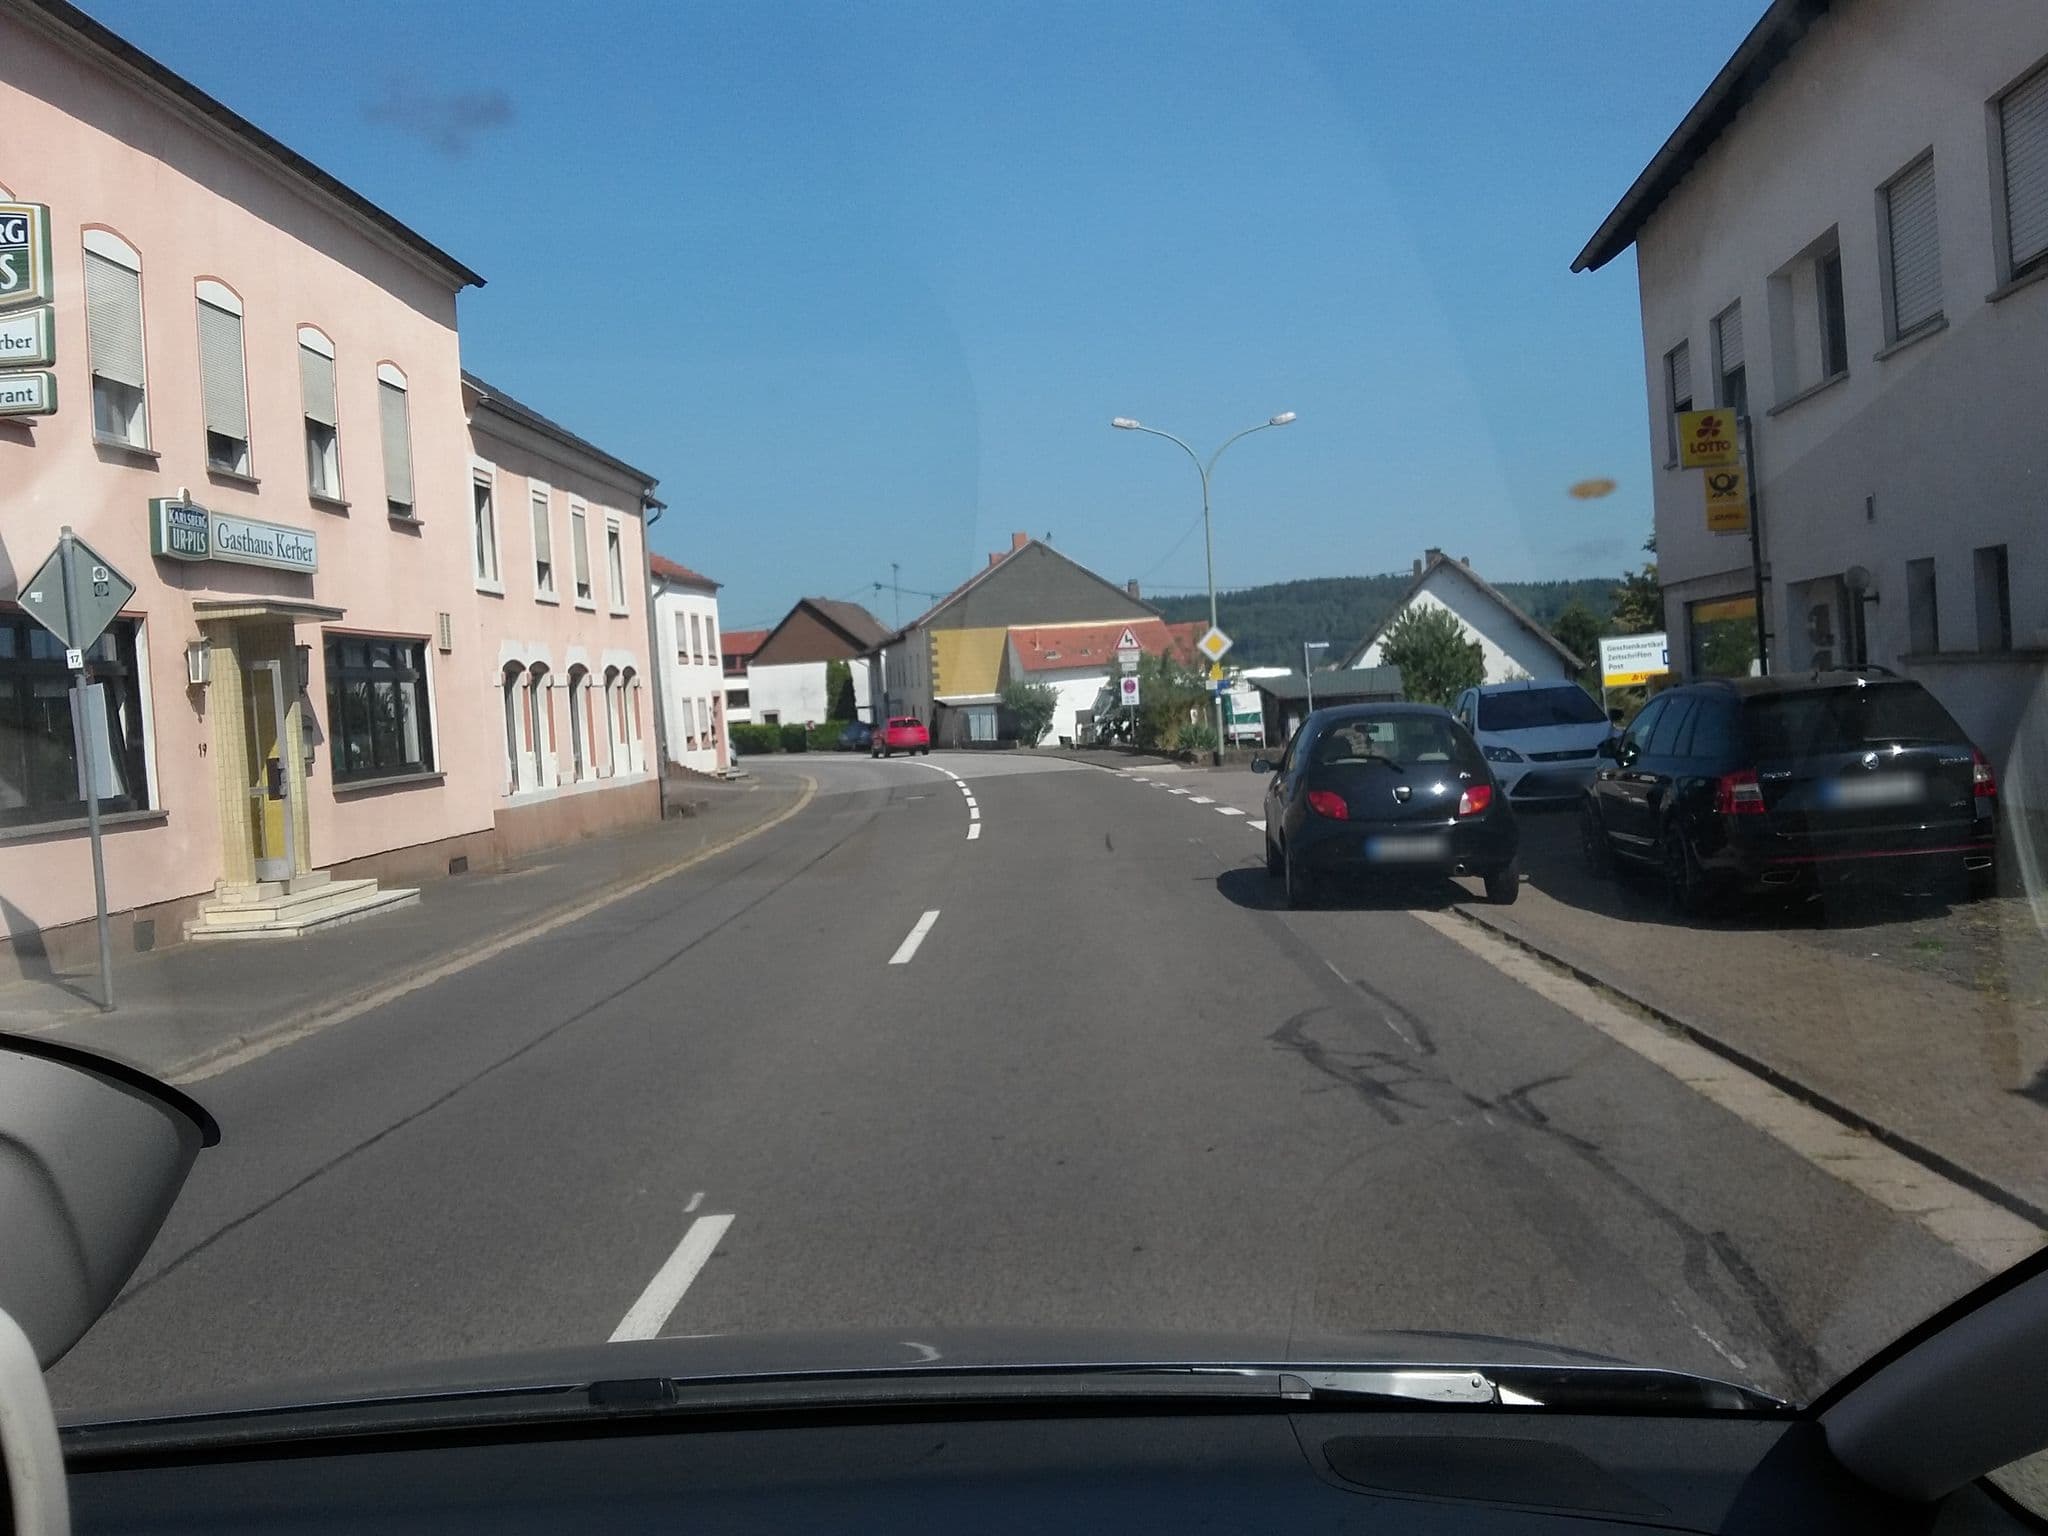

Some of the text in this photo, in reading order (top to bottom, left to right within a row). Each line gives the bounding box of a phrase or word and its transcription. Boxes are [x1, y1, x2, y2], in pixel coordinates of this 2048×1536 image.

[1690, 440, 1731, 454] LOTTO
[168, 509, 207, 528] KARLSBERG
[172, 527, 206, 553] UR-PILS
[217, 523, 313, 562] Gasthaus Kerber
[70, 654, 80, 663] 17
[1607, 651, 1652, 661] Zeitschriften
[1608, 663, 1624, 671] Post
